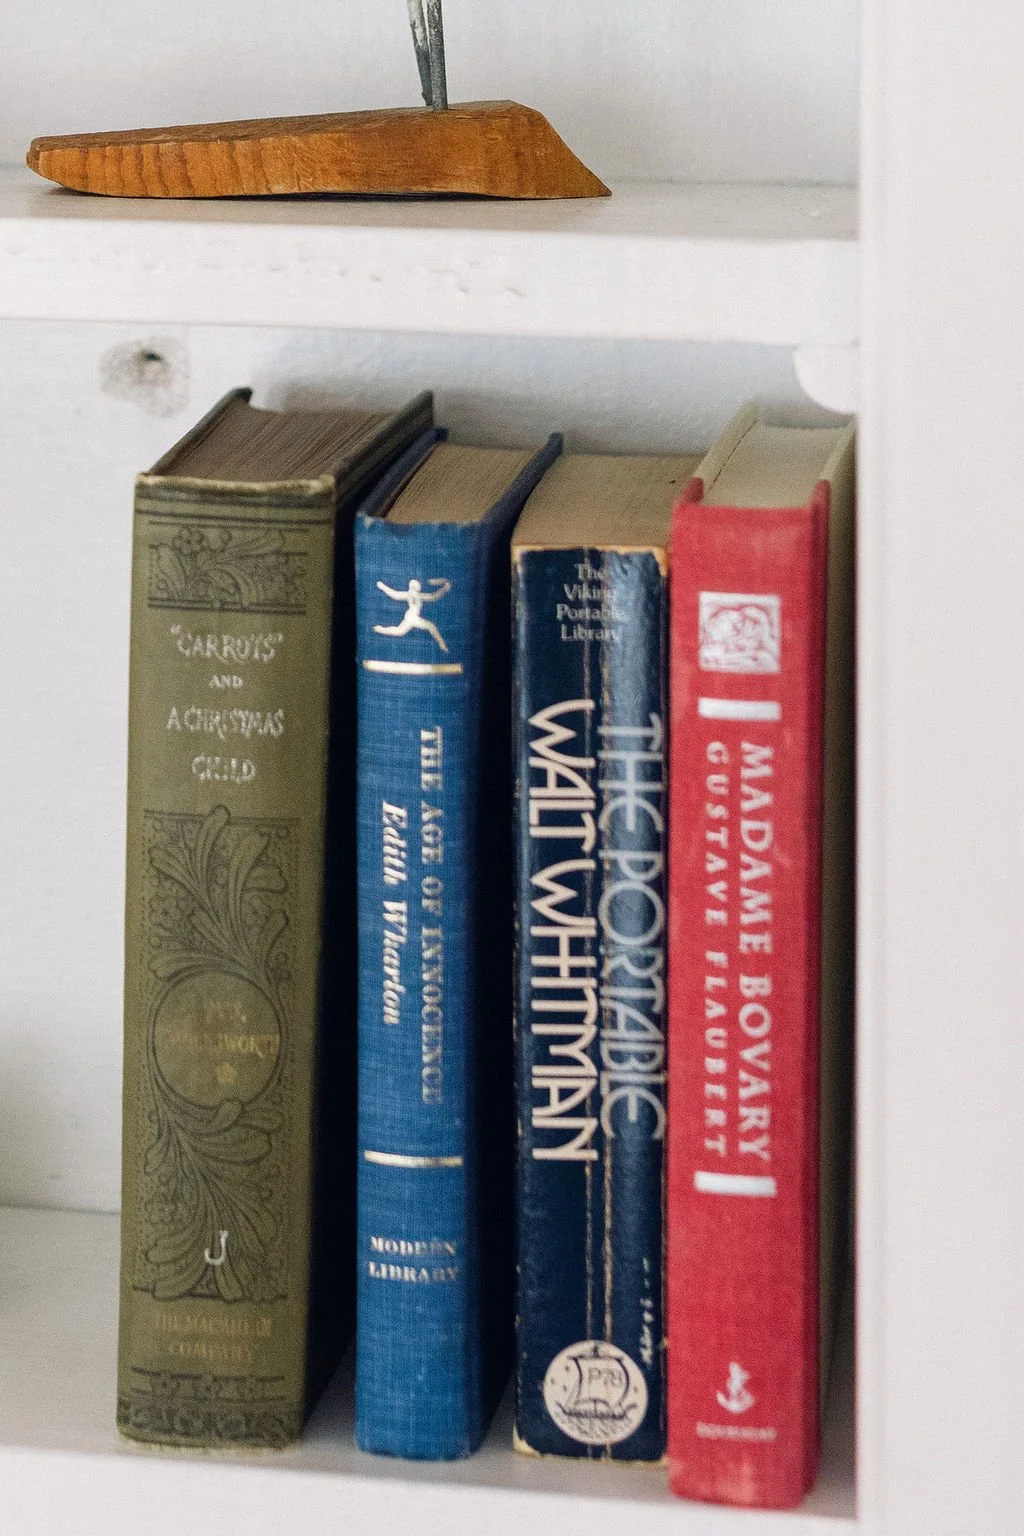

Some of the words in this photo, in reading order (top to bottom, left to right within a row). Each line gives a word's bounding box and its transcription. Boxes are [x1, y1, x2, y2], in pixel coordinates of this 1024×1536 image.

[208, 674, 245, 689] AND
[420, 724, 444, 792] THE
[528, 698, 597, 853] WALT
[597, 712, 665, 833] THE
[381, 799, 409, 887] Edith
[420, 800, 444, 865] AGE
[420, 875, 444, 917] OF
[704, 740, 729, 927] GUSTAVE
[738, 739, 774, 954] MADAME
[382, 899, 410, 1026] Wharton
[420, 924, 444, 1105] INNOCENCE
[530, 858, 599, 1161] WHITMAN
[597, 849, 667, 1141] PORTABLE
[704, 949, 729, 1159] FLAUBERT
[738, 973, 774, 1162] BOVARY
[367, 1260, 459, 1283] LIBRARY
[369, 1235, 457, 1257] MODERN
